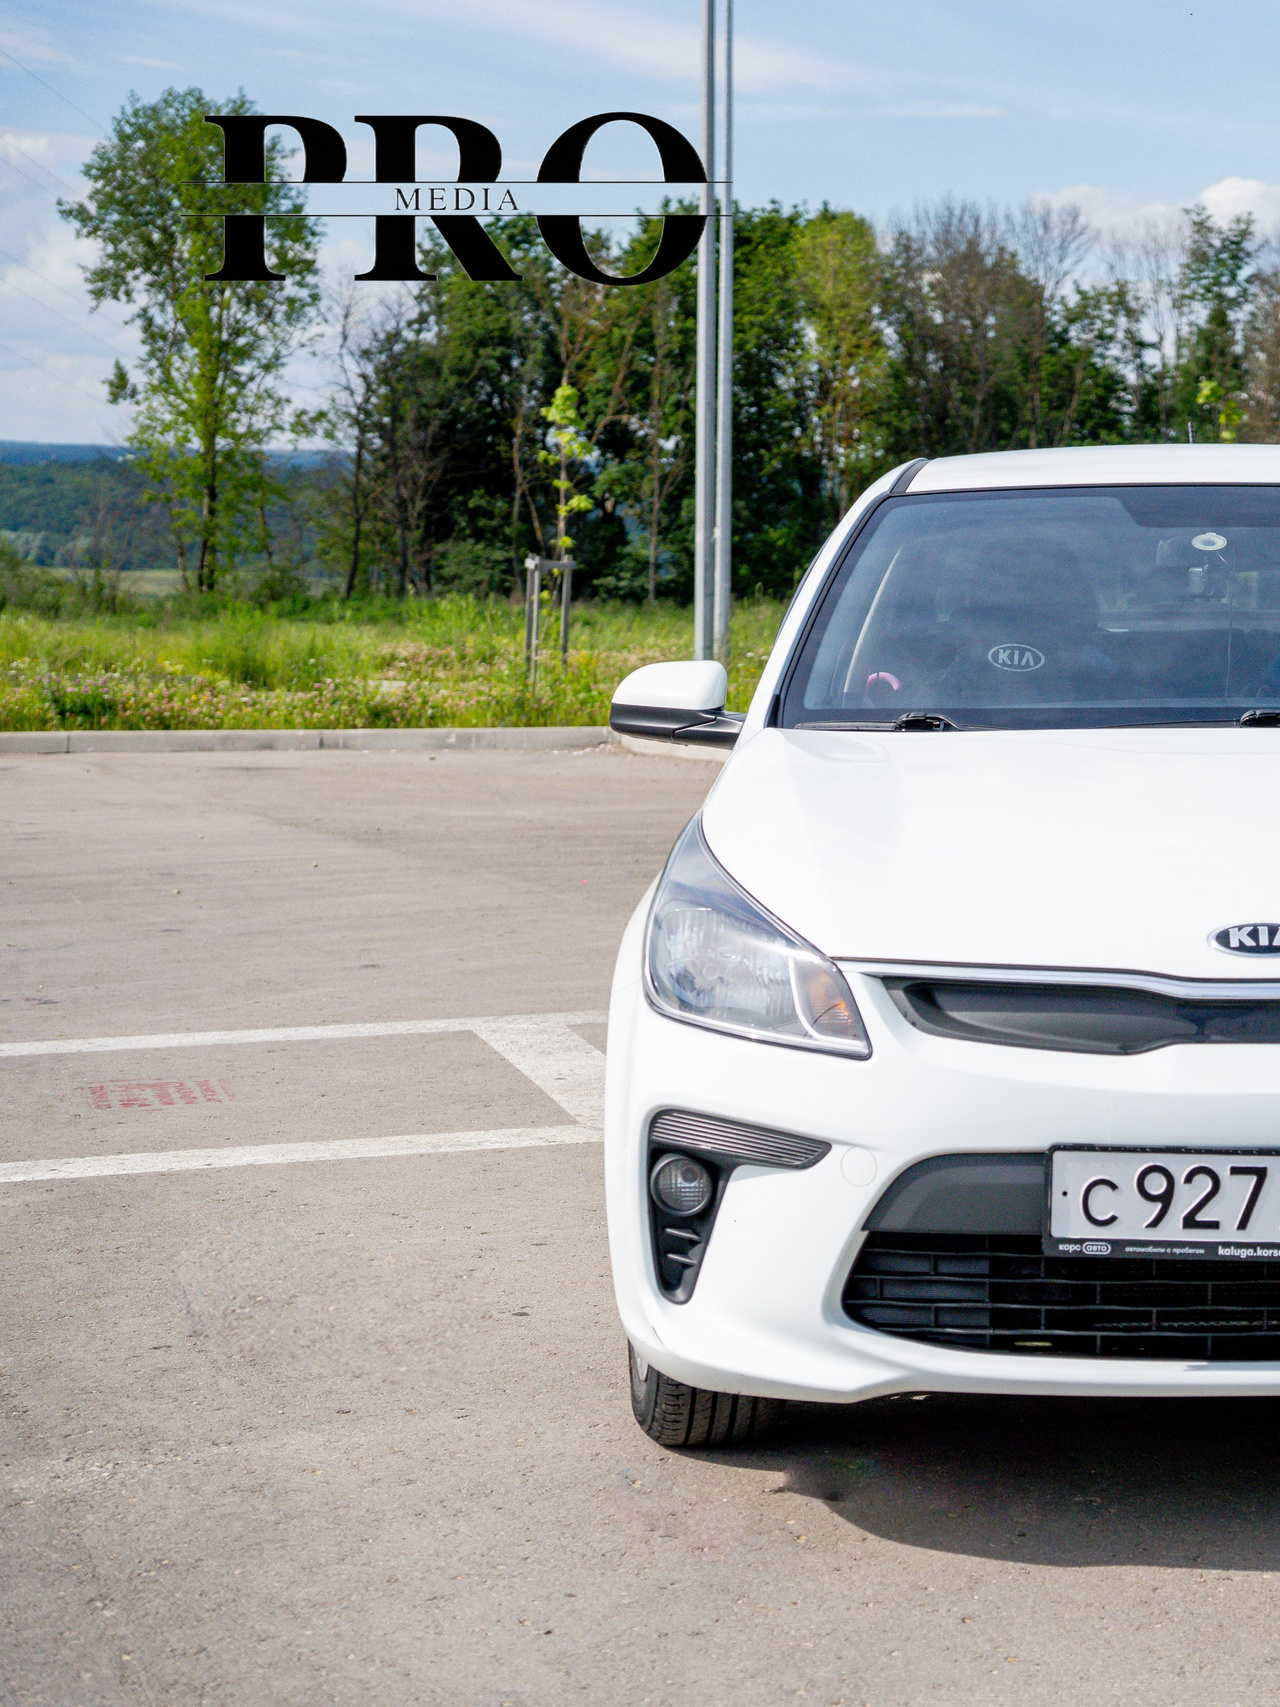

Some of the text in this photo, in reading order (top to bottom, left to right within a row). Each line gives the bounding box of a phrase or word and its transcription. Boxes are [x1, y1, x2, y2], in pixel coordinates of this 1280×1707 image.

[998, 649, 1035, 666] KIA
[1086, 1244, 1107, 1252] авто
[1125, 1245, 1166, 1253] автомобили
